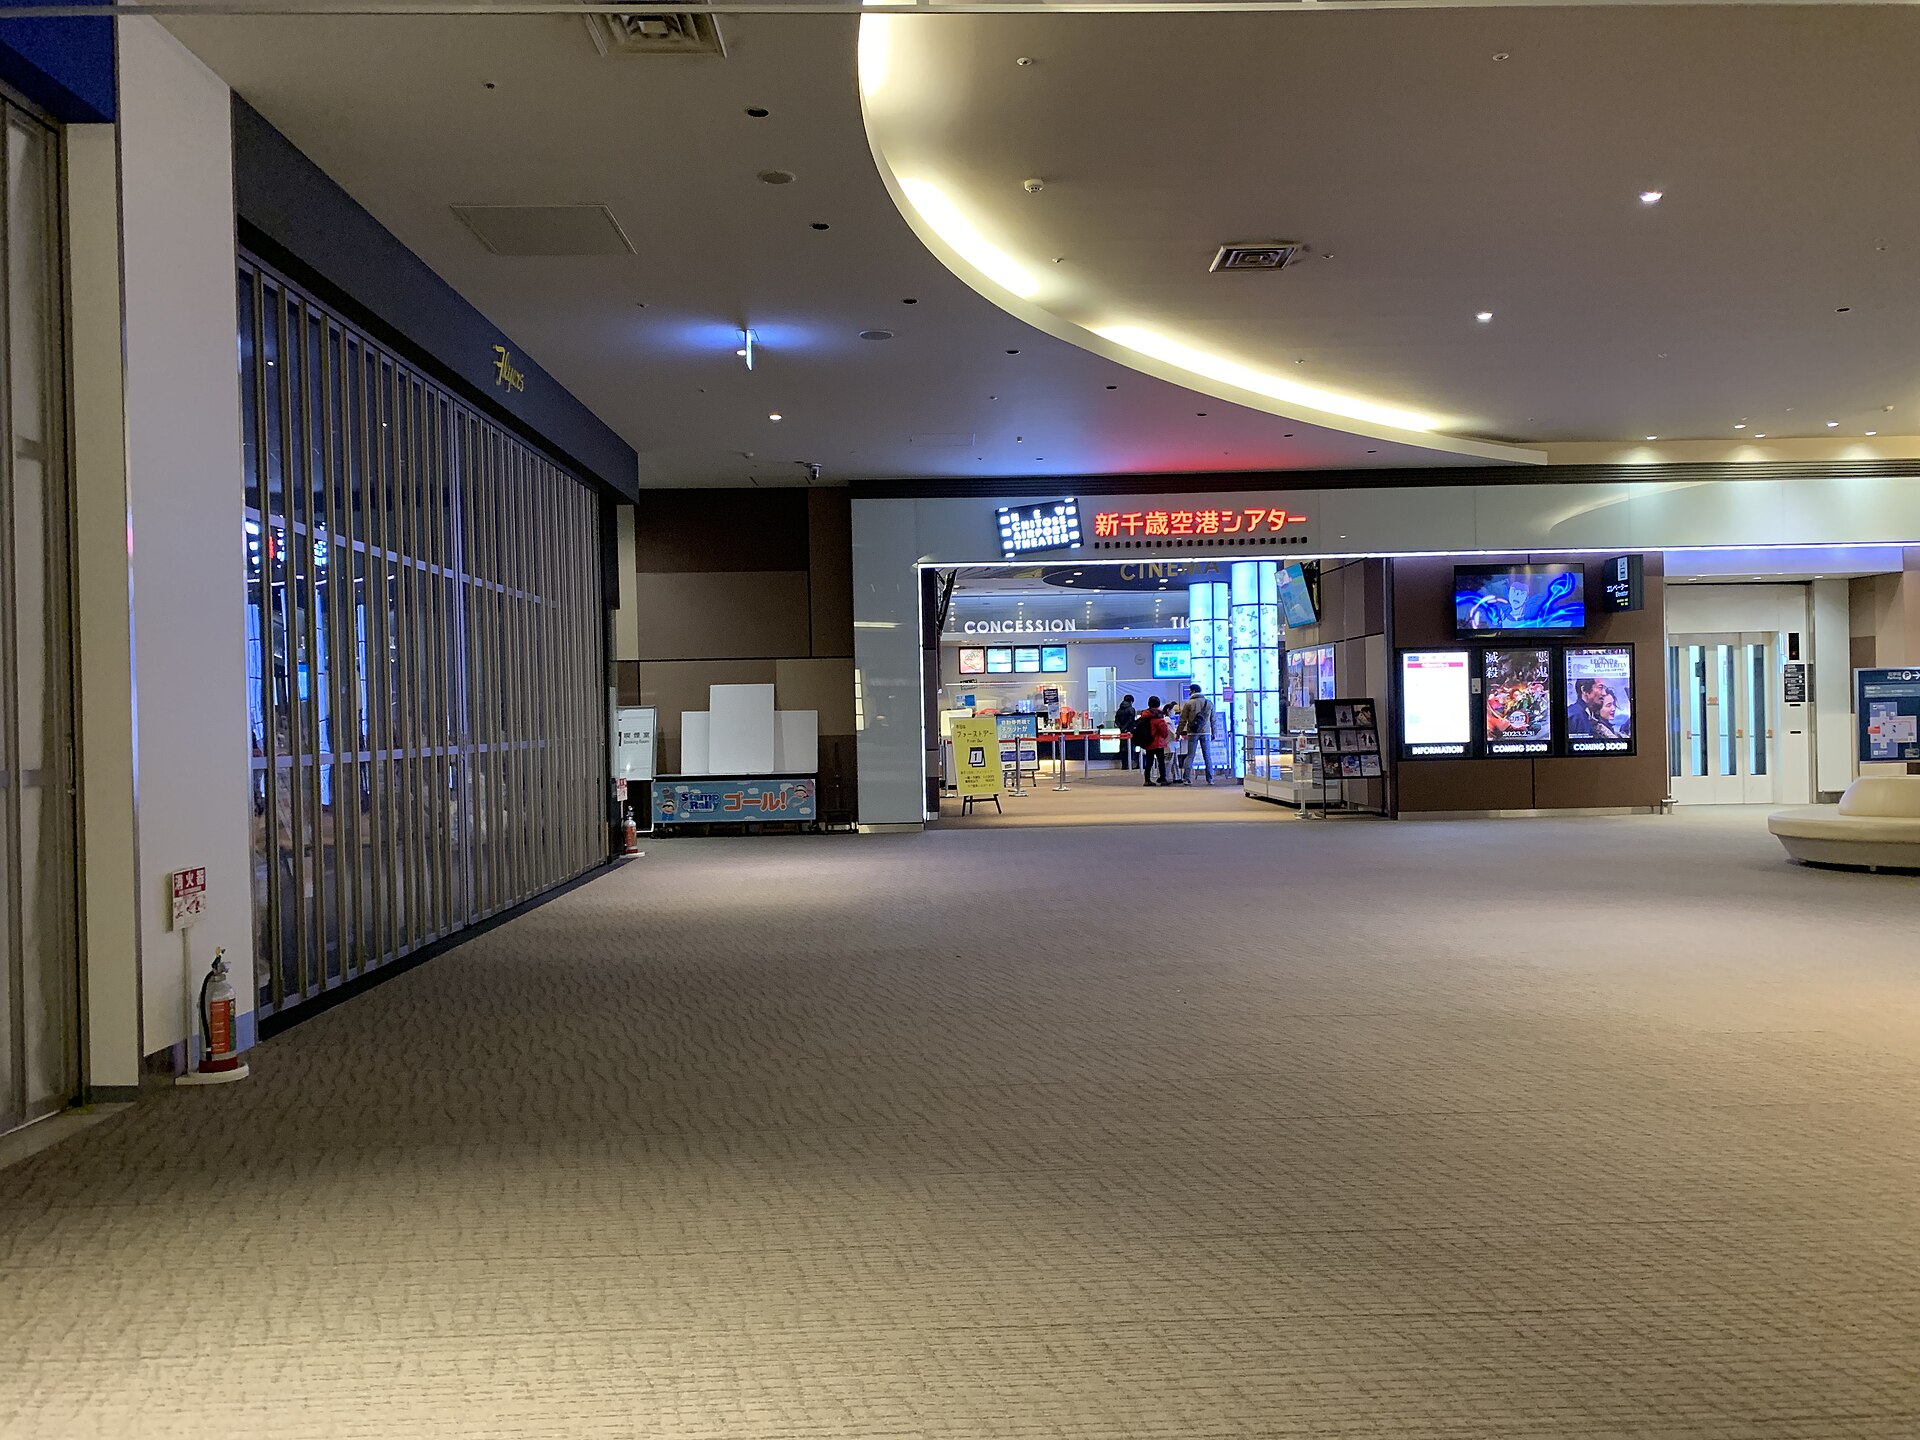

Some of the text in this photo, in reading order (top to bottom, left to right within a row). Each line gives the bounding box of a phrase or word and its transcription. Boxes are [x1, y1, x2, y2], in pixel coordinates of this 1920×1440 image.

[1012, 515, 1066, 532] CHITOSE
[1095, 508, 1307, 536] 新千歳空港シアター
[1013, 524, 1067, 541] AIRPORT
[1014, 533, 1069, 550] THEATER
[1120, 561, 1220, 581] CINEMA
[964, 619, 1076, 634] CONCESSION
[956, 730, 995, 738] ファーストデー
[1412, 746, 1464, 755] INFORMATION
[1493, 744, 1548, 753] COMING SOON
[1573, 743, 1605, 751] COMING
[681, 792, 720, 803] Stamp
[723, 791, 787, 812] ゴール!
[690, 801, 719, 811] Rally
[174, 869, 205, 890] 消火器
